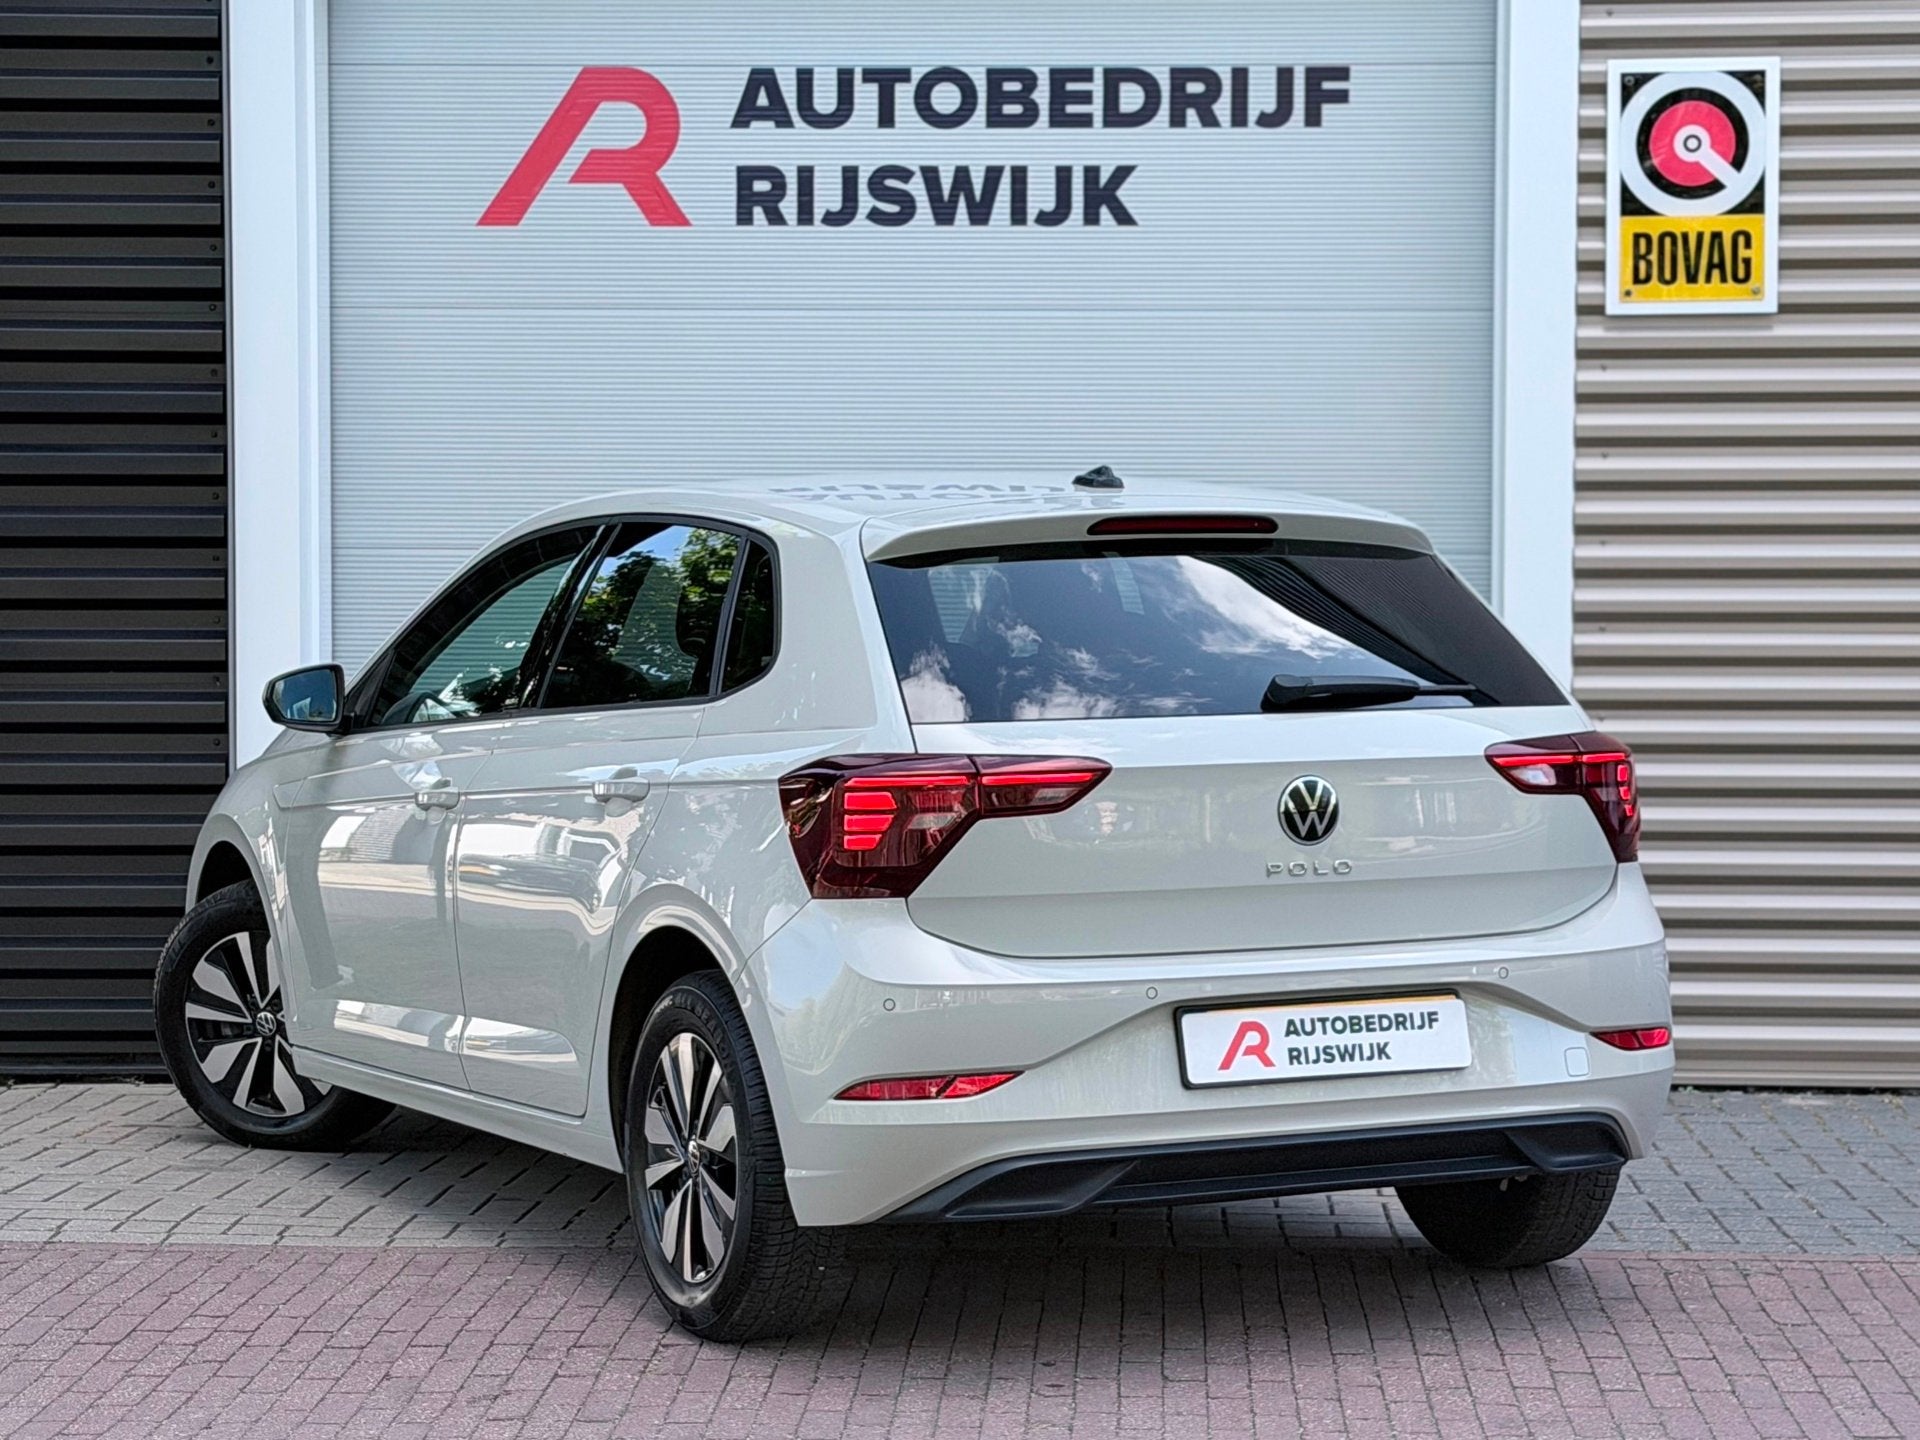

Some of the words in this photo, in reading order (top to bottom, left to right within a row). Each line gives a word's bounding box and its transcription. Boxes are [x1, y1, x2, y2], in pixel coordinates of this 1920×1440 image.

[730, 65, 1350, 130] AUTOBEDRIJF
[736, 164, 1138, 227] RIJSWIJK
[1632, 230, 1753, 286] BOVAG
[1266, 860, 1353, 878] POLO
[1284, 1011, 1440, 1038] AUTOBEDRIJF
[1288, 1042, 1392, 1066] RIJSWIJK
